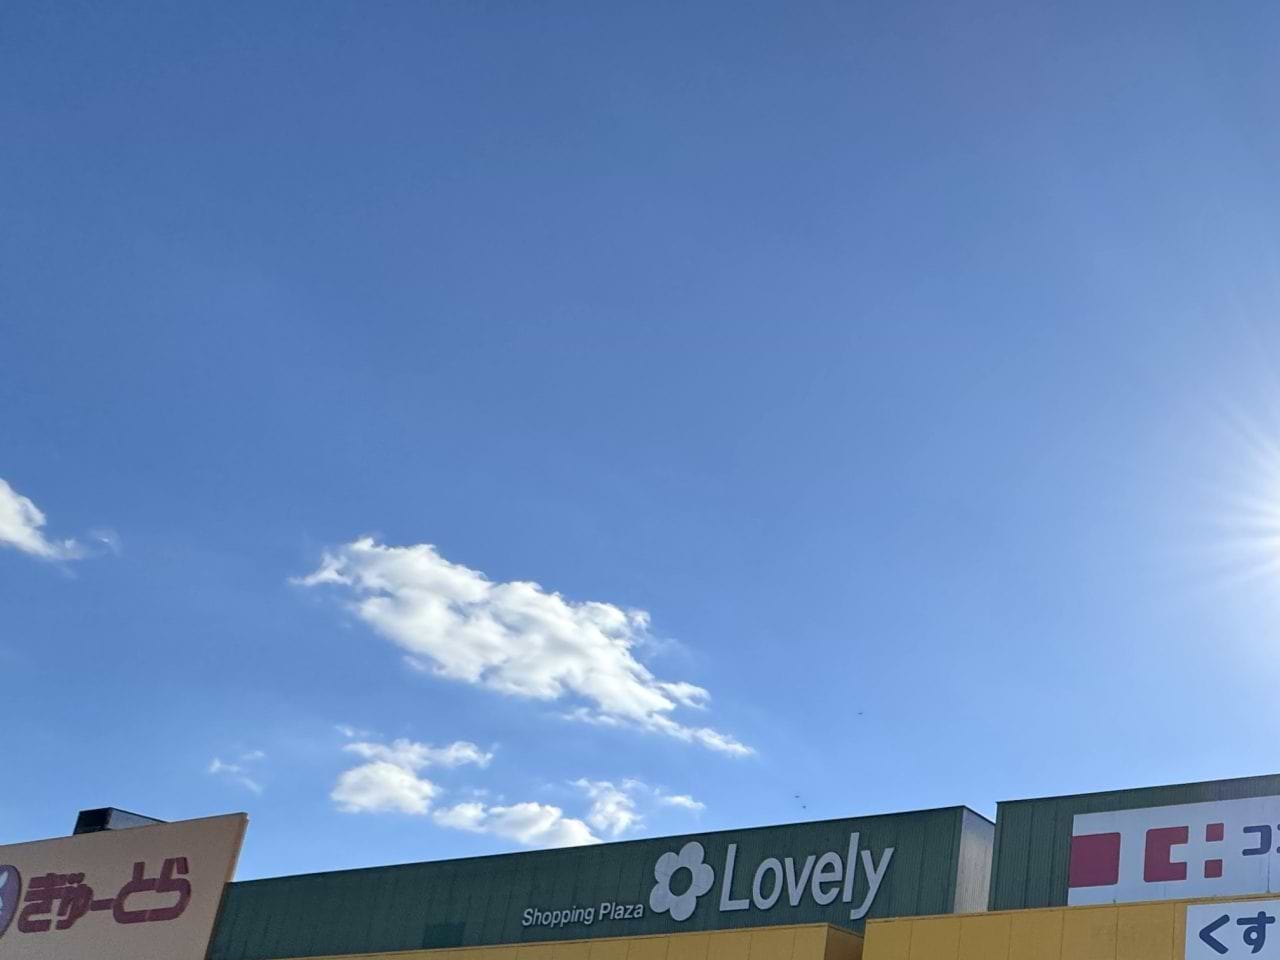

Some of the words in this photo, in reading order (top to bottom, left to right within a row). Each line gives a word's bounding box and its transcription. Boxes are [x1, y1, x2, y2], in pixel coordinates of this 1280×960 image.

[17, 856, 192, 934] ぎゅーとら
[521, 906, 595, 928] Shopping
[598, 901, 644, 921] Plaza
[718, 831, 895, 920] Lovely
